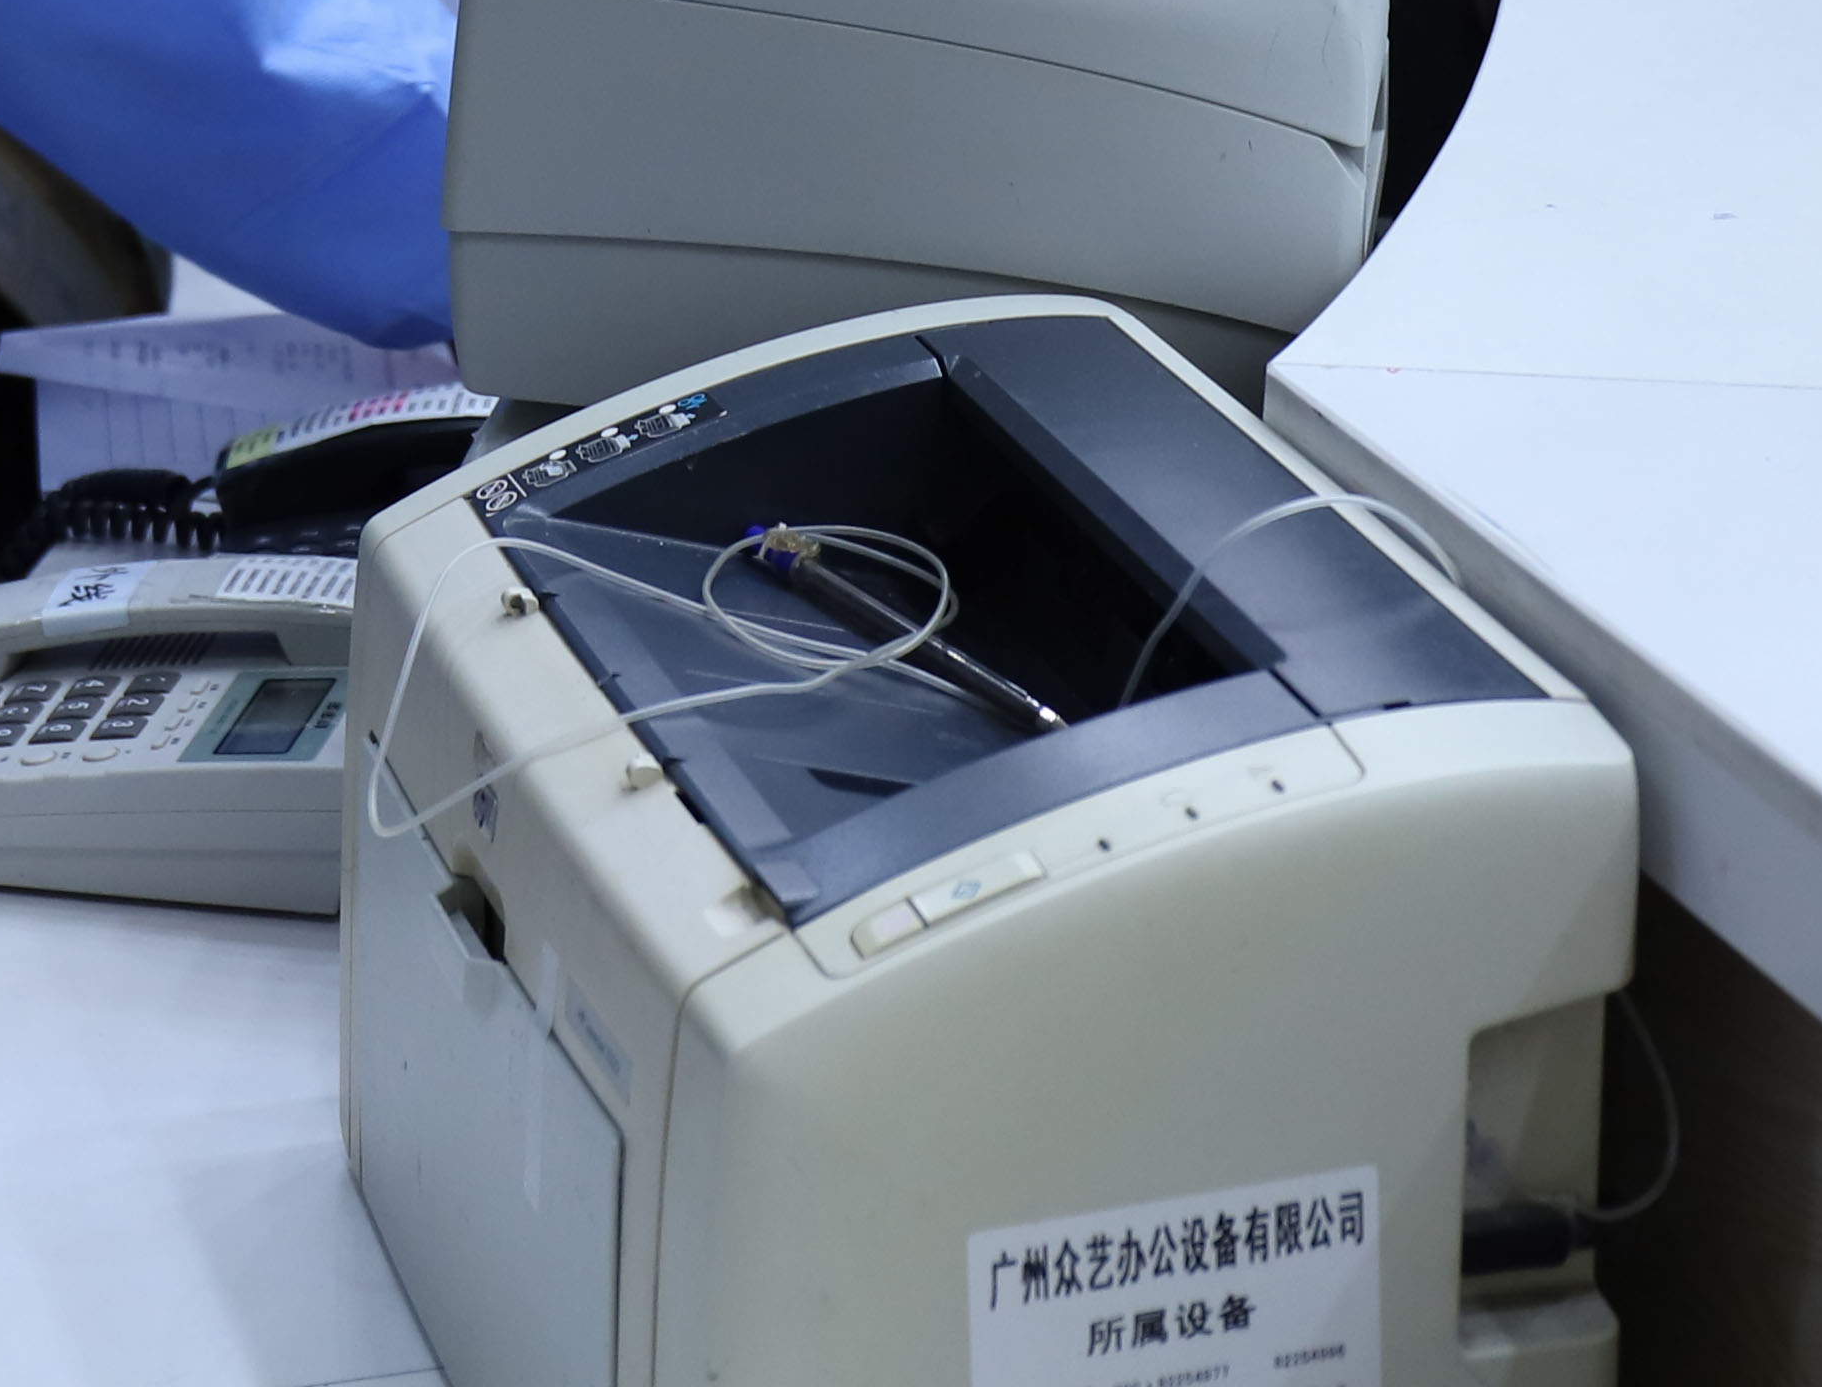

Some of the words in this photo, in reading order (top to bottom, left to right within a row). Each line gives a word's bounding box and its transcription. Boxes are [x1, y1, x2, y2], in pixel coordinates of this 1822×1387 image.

[989, 1191, 1365, 1310] 广州众艺办公设备有限公司
[1087, 1293, 1256, 1357] 所属设备
